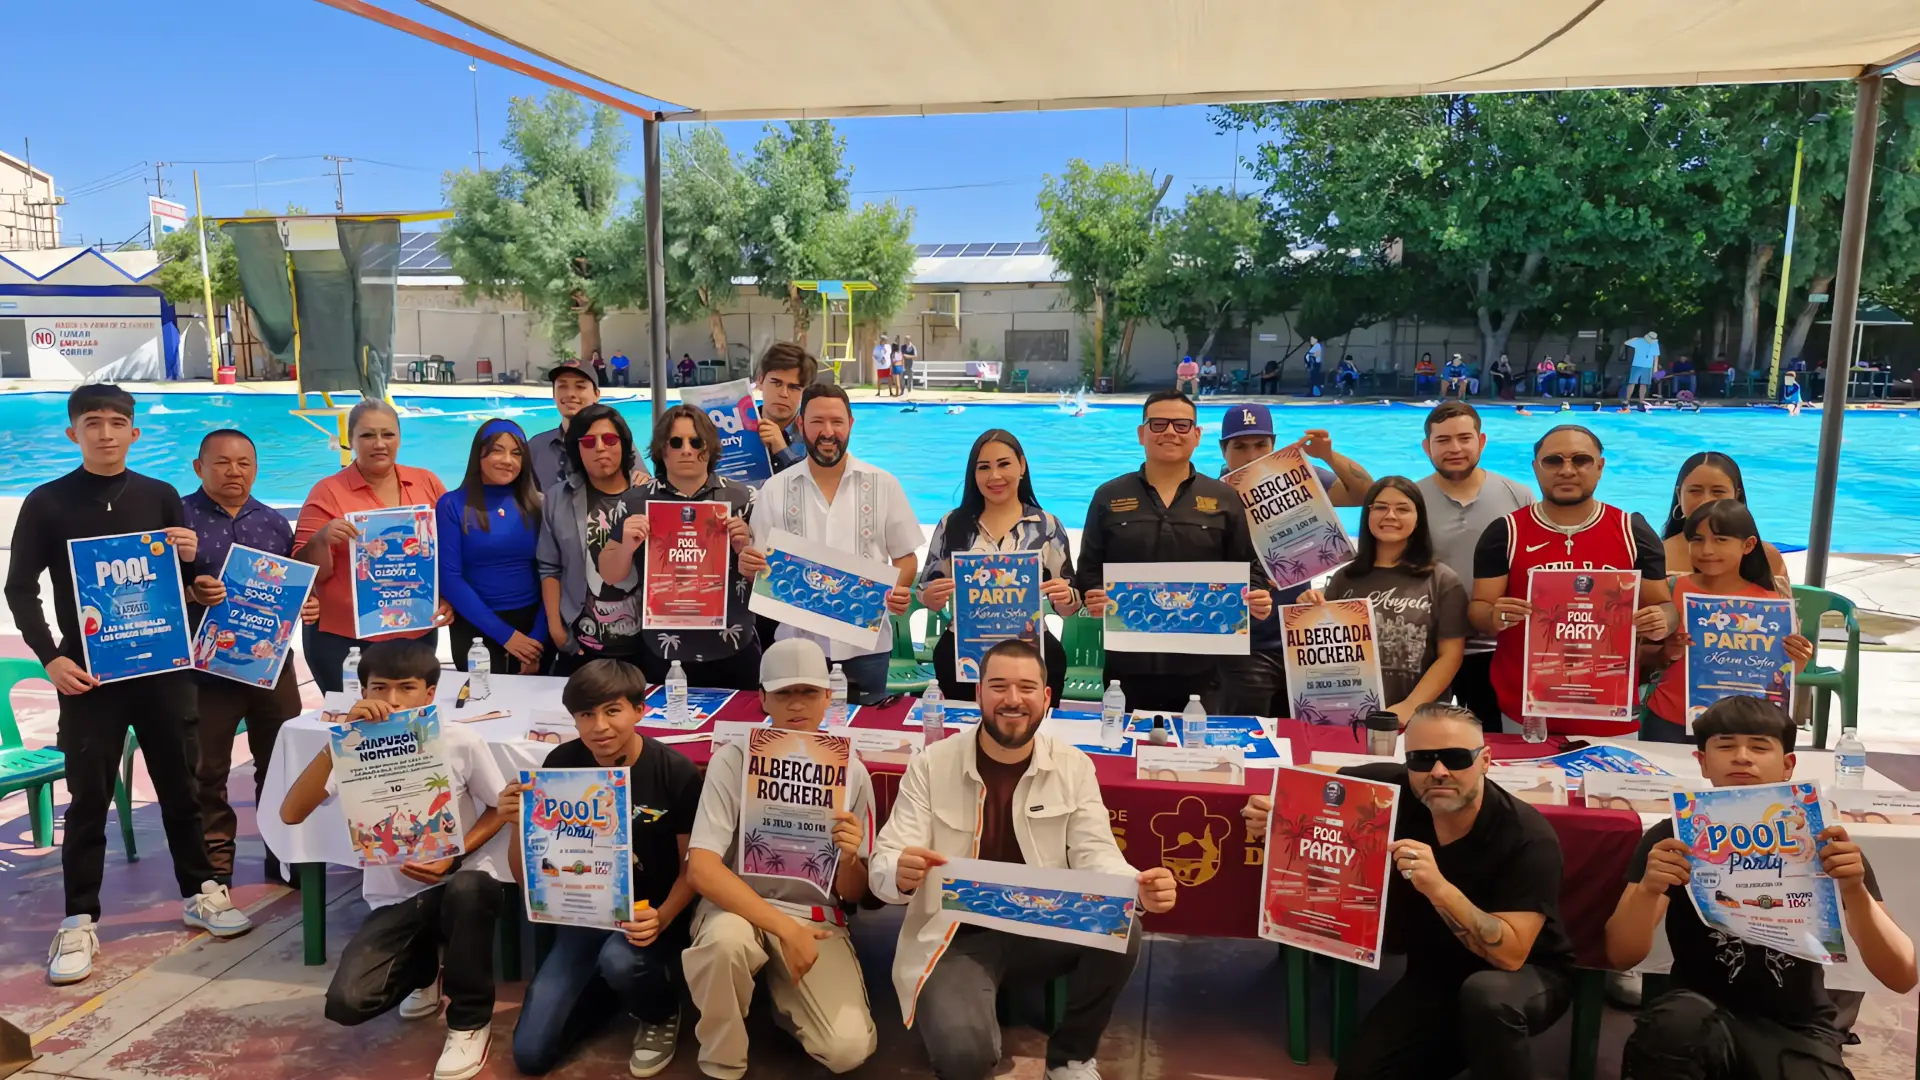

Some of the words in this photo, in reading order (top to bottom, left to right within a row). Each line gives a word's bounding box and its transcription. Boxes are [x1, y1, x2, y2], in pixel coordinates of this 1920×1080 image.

[36, 332, 52, 345] NO
[1242, 408, 1256, 425] LA
[720, 436, 742, 448] arty
[1250, 485, 1313, 524] ROCKERA
[678, 538, 698, 548] POOL
[669, 548, 706, 562] PARTY
[96, 556, 156, 586] POOL
[272, 585, 282, 594] TO
[968, 588, 1028, 604] PARTY
[969, 606, 1000, 619] Karen
[1567, 611, 1594, 622] POOL
[1287, 624, 1372, 647] ALBERCADA
[1555, 623, 1605, 640] PARTY
[1704, 632, 1776, 652] PARTY
[1297, 645, 1365, 666] ROCKERA
[1704, 652, 1742, 665] Karen
[748, 755, 846, 787] ALBERCADA
[757, 779, 833, 809] ROCKERA
[544, 798, 606, 824] POOL
[772, 818, 792, 828] JULIO
[556, 820, 596, 847] Party
[1314, 826, 1344, 844] POOL
[1707, 819, 1798, 852] POOL
[1300, 838, 1357, 866] PARTY
[1729, 851, 1784, 878] Party
